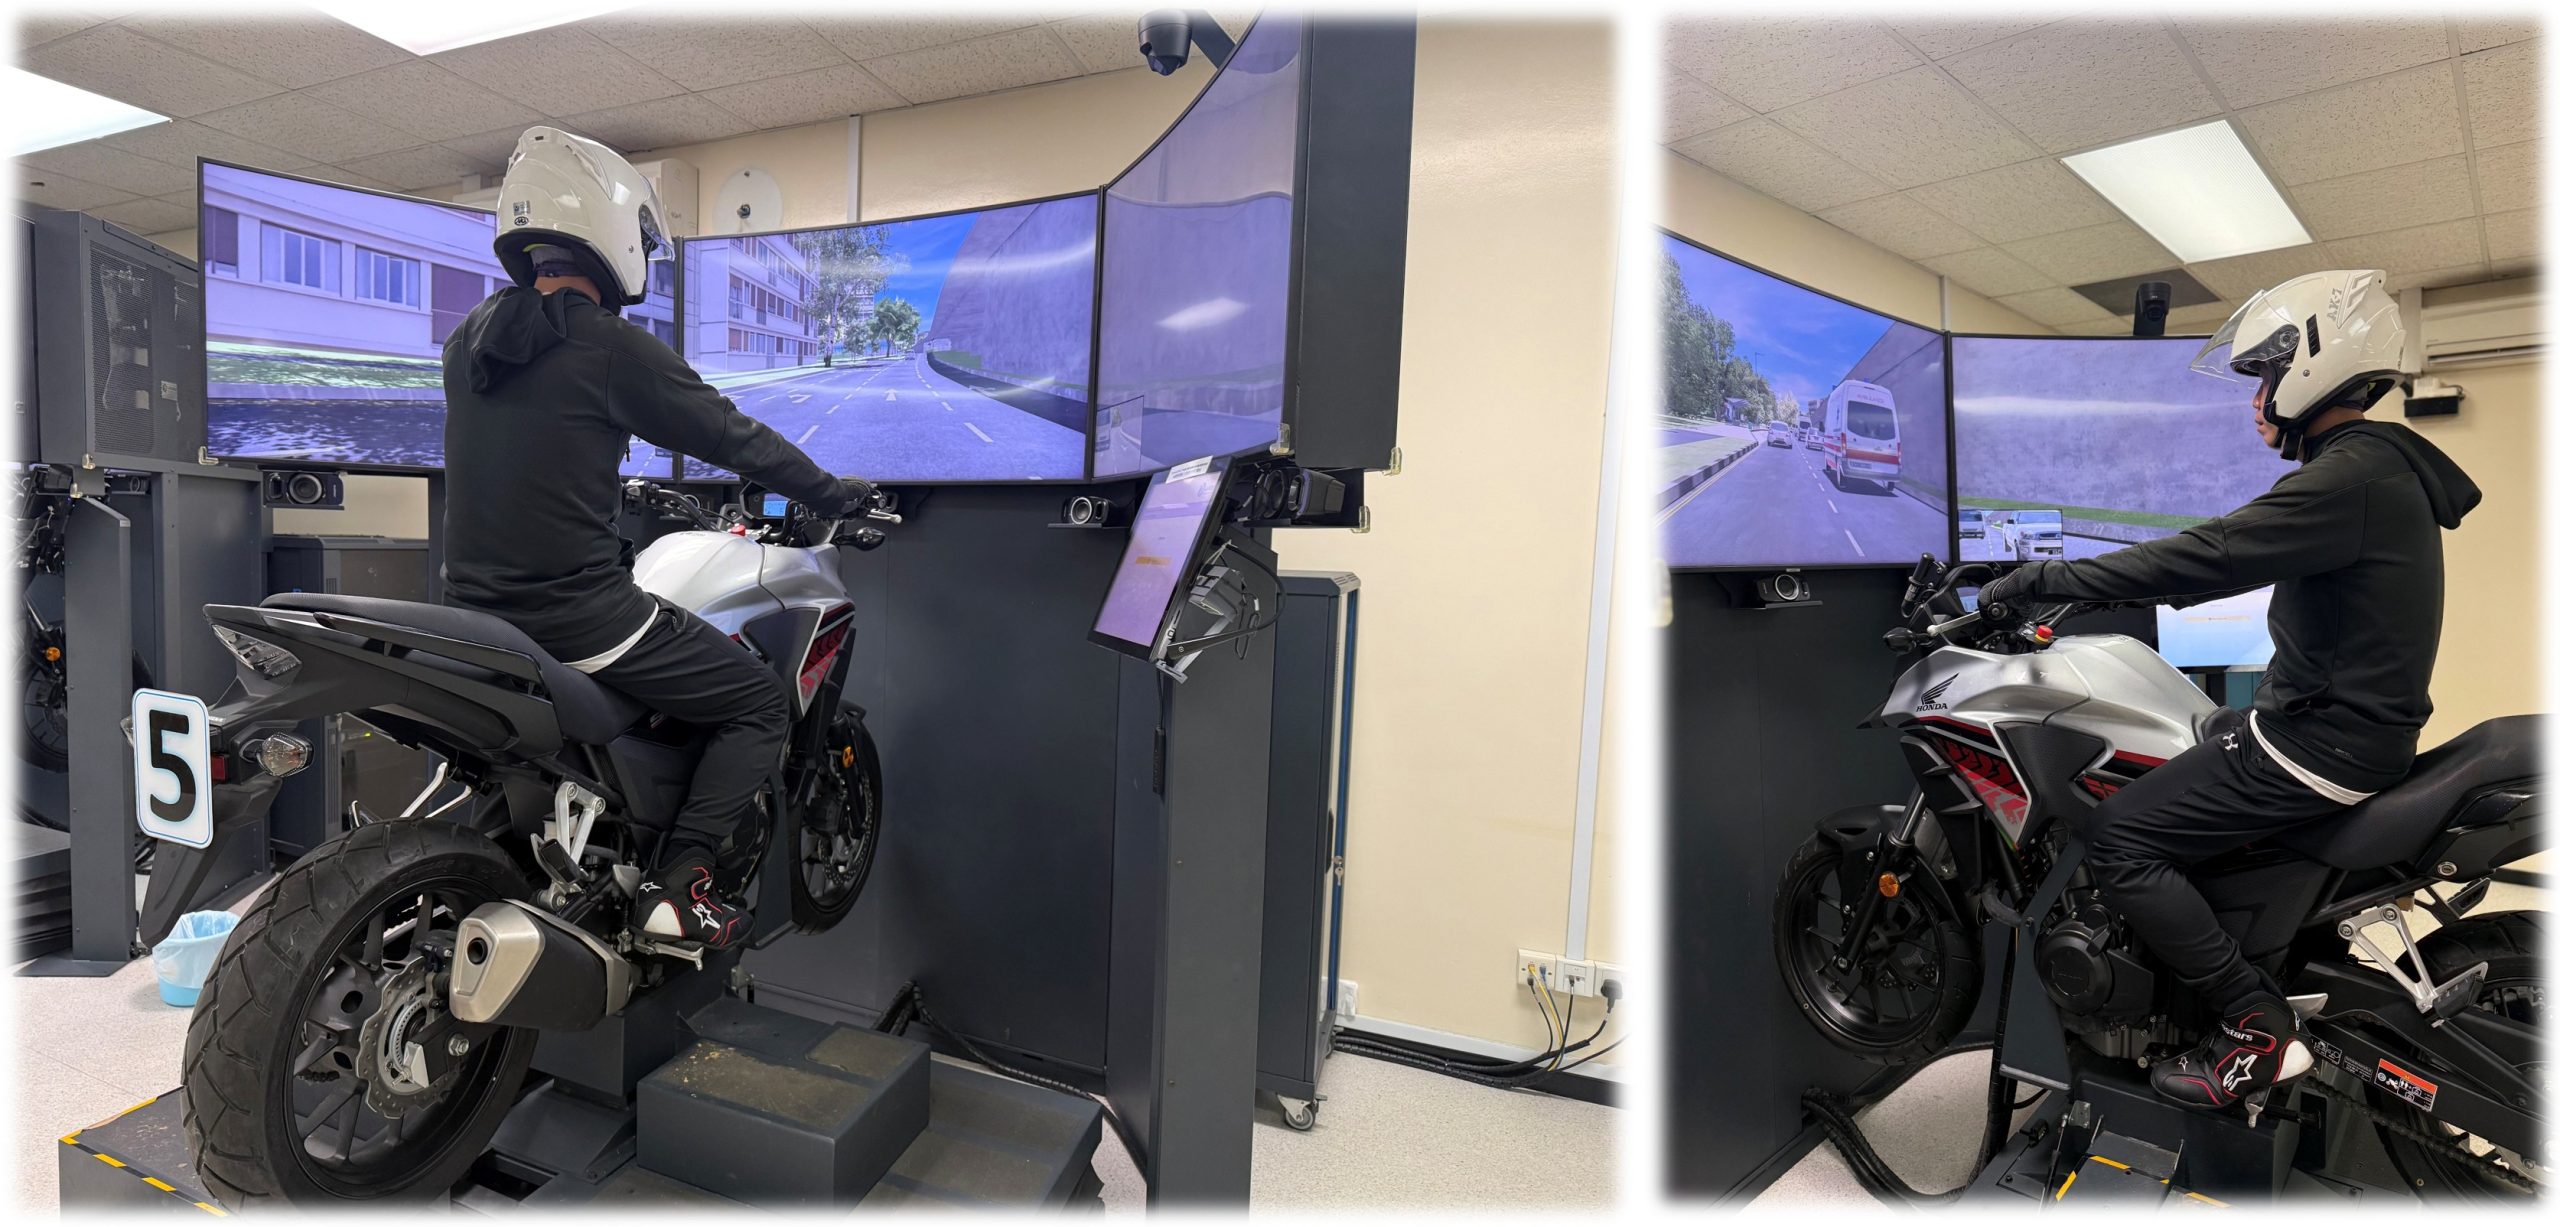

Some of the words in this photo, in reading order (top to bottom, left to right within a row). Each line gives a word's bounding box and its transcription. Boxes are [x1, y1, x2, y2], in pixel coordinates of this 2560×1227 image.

[1915, 702, 1948, 712] HONDA
[149, 709, 197, 822] 5
[2221, 1023, 2253, 1041] stars
